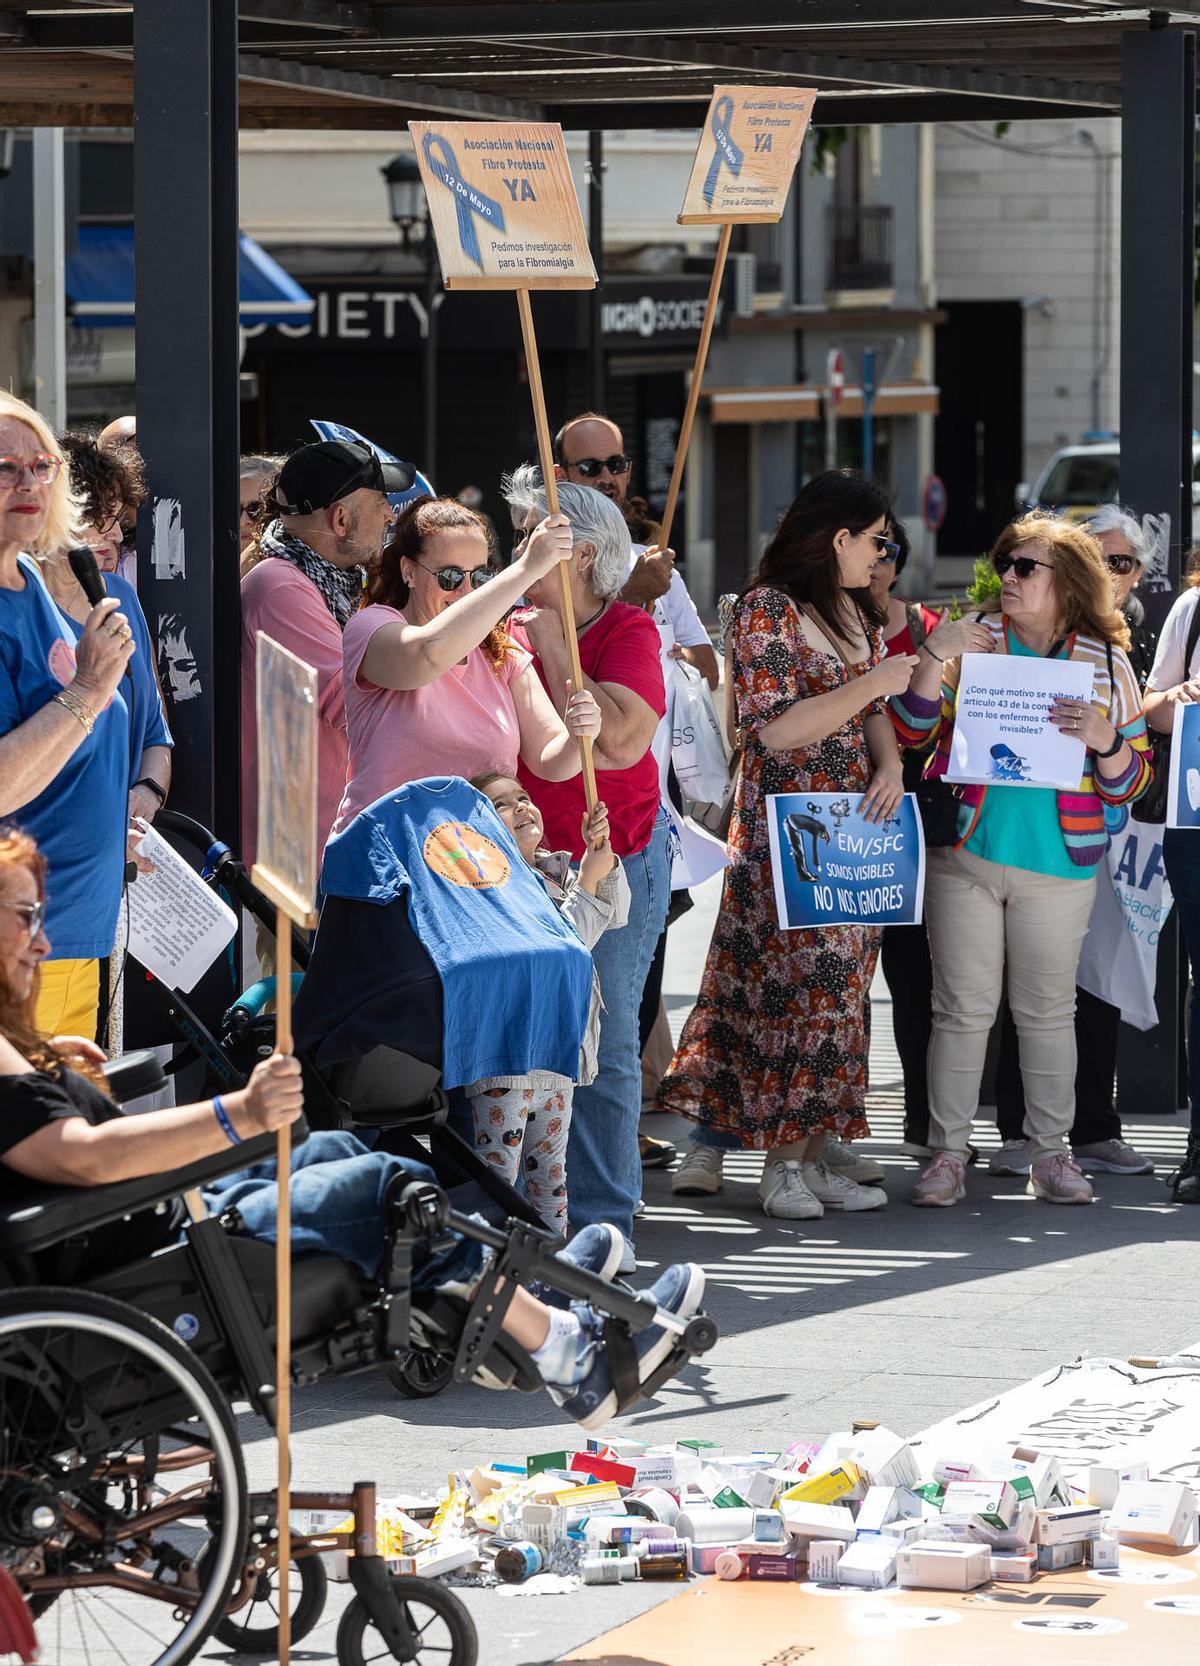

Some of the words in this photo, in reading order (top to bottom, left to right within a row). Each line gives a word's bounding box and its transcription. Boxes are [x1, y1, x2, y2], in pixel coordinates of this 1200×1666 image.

[464, 139, 512, 150] Asociación
[516, 139, 554, 151] Nacional
[754, 134, 772, 152] YA
[482, 158, 505, 170] Fibro
[508, 160, 546, 170] Protesta
[444, 174, 454, 186] 12
[456, 182, 468, 196] De
[470, 194, 492, 216] Mayo
[503, 178, 536, 202] YA
[491, 242, 524, 252] Pedimos
[525, 242, 572, 254] investigación
[499, 260, 515, 268] para
[517, 258, 524, 267] la
[526, 258, 574, 270] Fibromialgia
[966, 686, 986, 694] ¿Con
[989, 688, 1004, 696] qué
[1006, 688, 1034, 697] motivo
[964, 698, 996, 706] artículo
[1022, 701, 1030, 709] la
[986, 711, 998, 719] los
[1000, 712, 1039, 722] enfermos
[1000, 724, 1043, 735] invisibles?
[838, 832, 904, 858] EM/SFC
[826, 863, 852, 880] SOMOS
[854, 863, 894, 880] VISIBLES
[814, 886, 833, 910] NO
[838, 888, 857, 915] NOS
[858, 884, 903, 916] IGNORES
